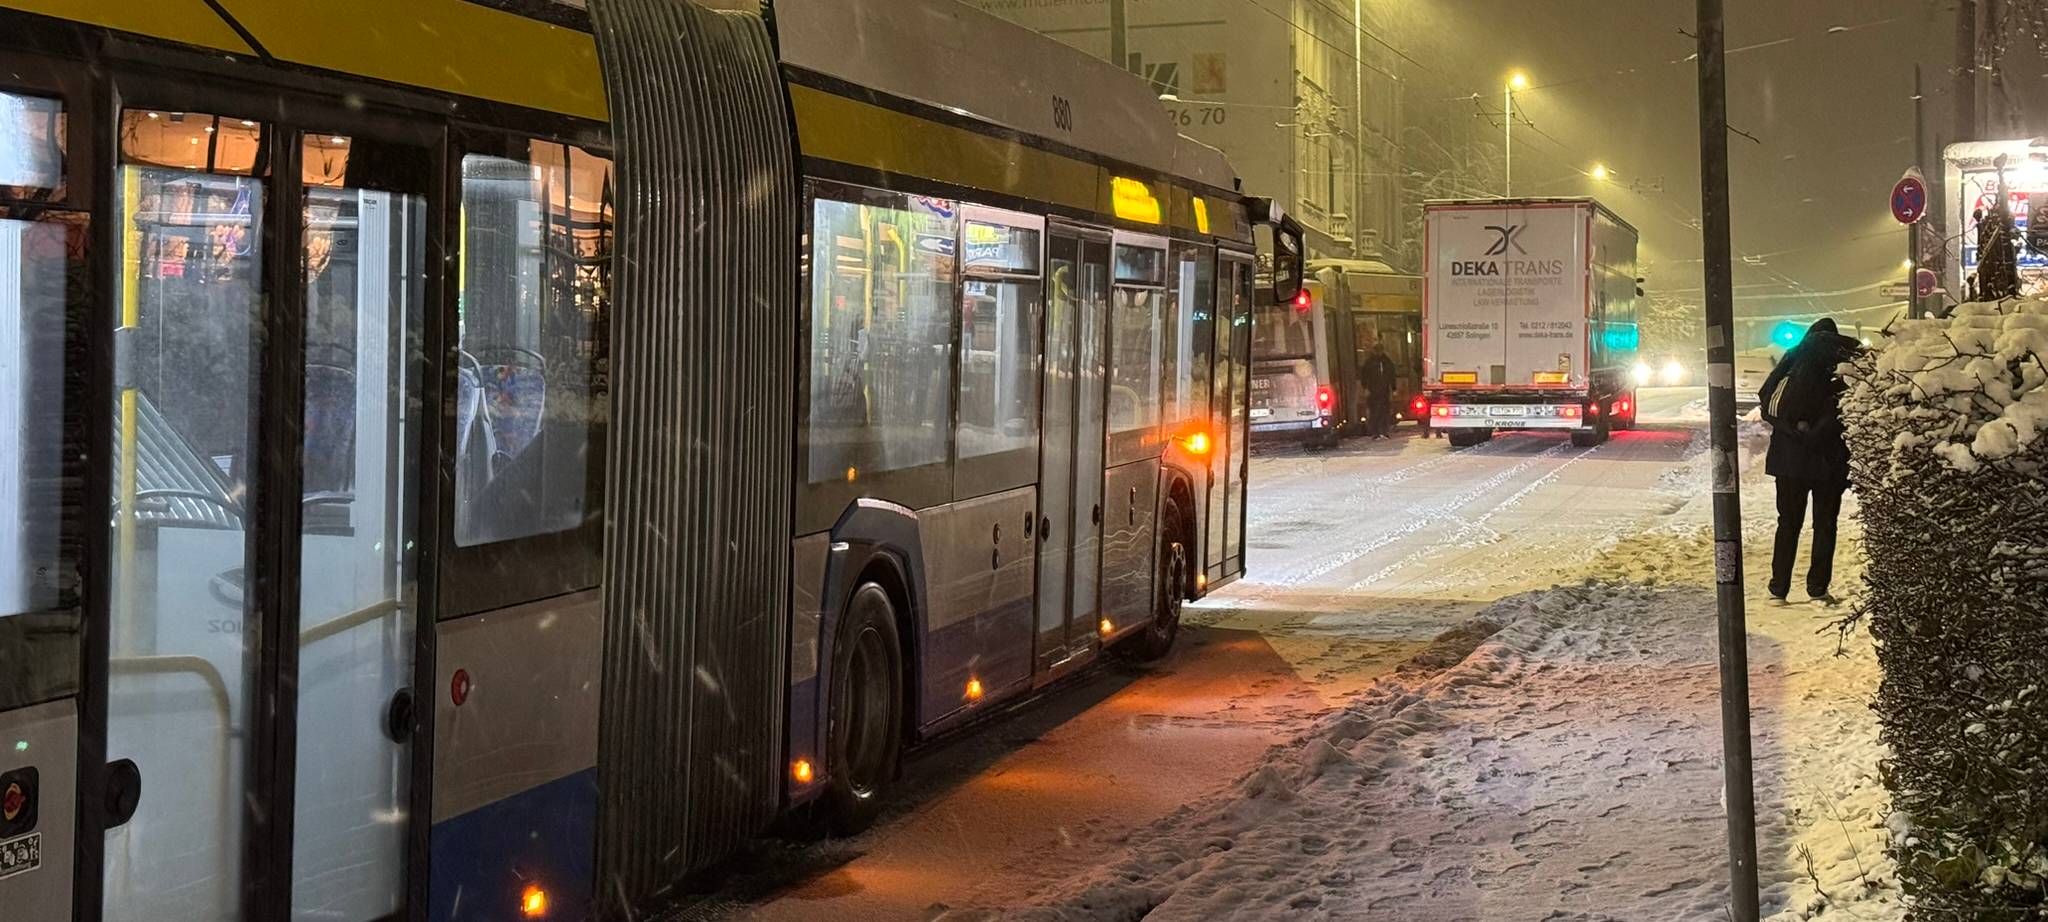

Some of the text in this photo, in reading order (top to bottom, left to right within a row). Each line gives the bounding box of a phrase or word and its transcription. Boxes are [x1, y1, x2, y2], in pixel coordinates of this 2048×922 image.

[1051, 94, 1072, 133] 880
[1200, 107, 1226, 125] 70
[1451, 259, 1563, 277] DEKA TRANS
